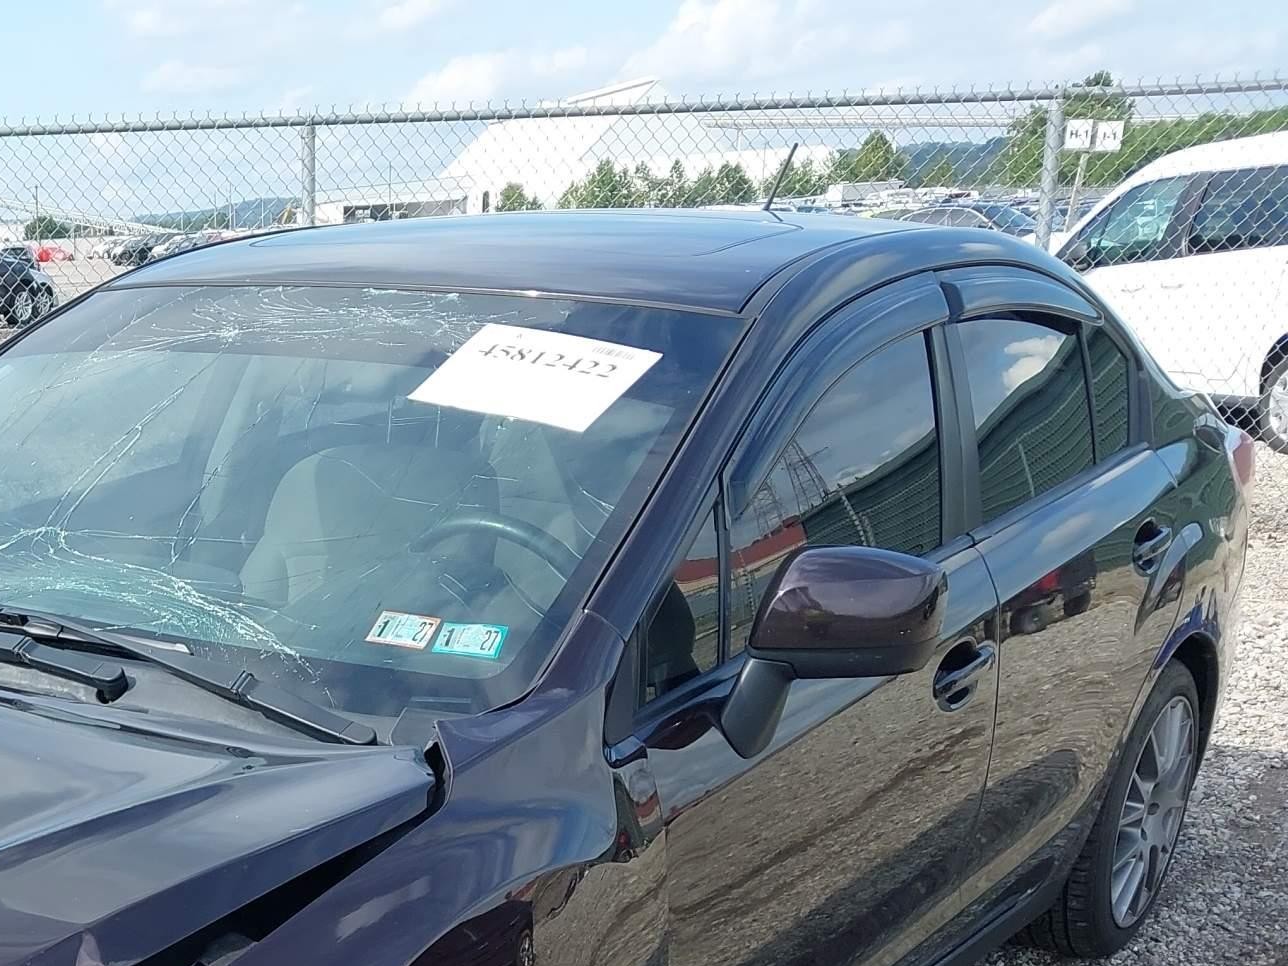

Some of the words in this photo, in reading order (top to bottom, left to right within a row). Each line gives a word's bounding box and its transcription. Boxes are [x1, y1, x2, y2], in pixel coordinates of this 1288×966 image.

[478, 343, 618, 378] 45812422
[412, 621, 433, 643] 27
[480, 630, 500, 652] 27
